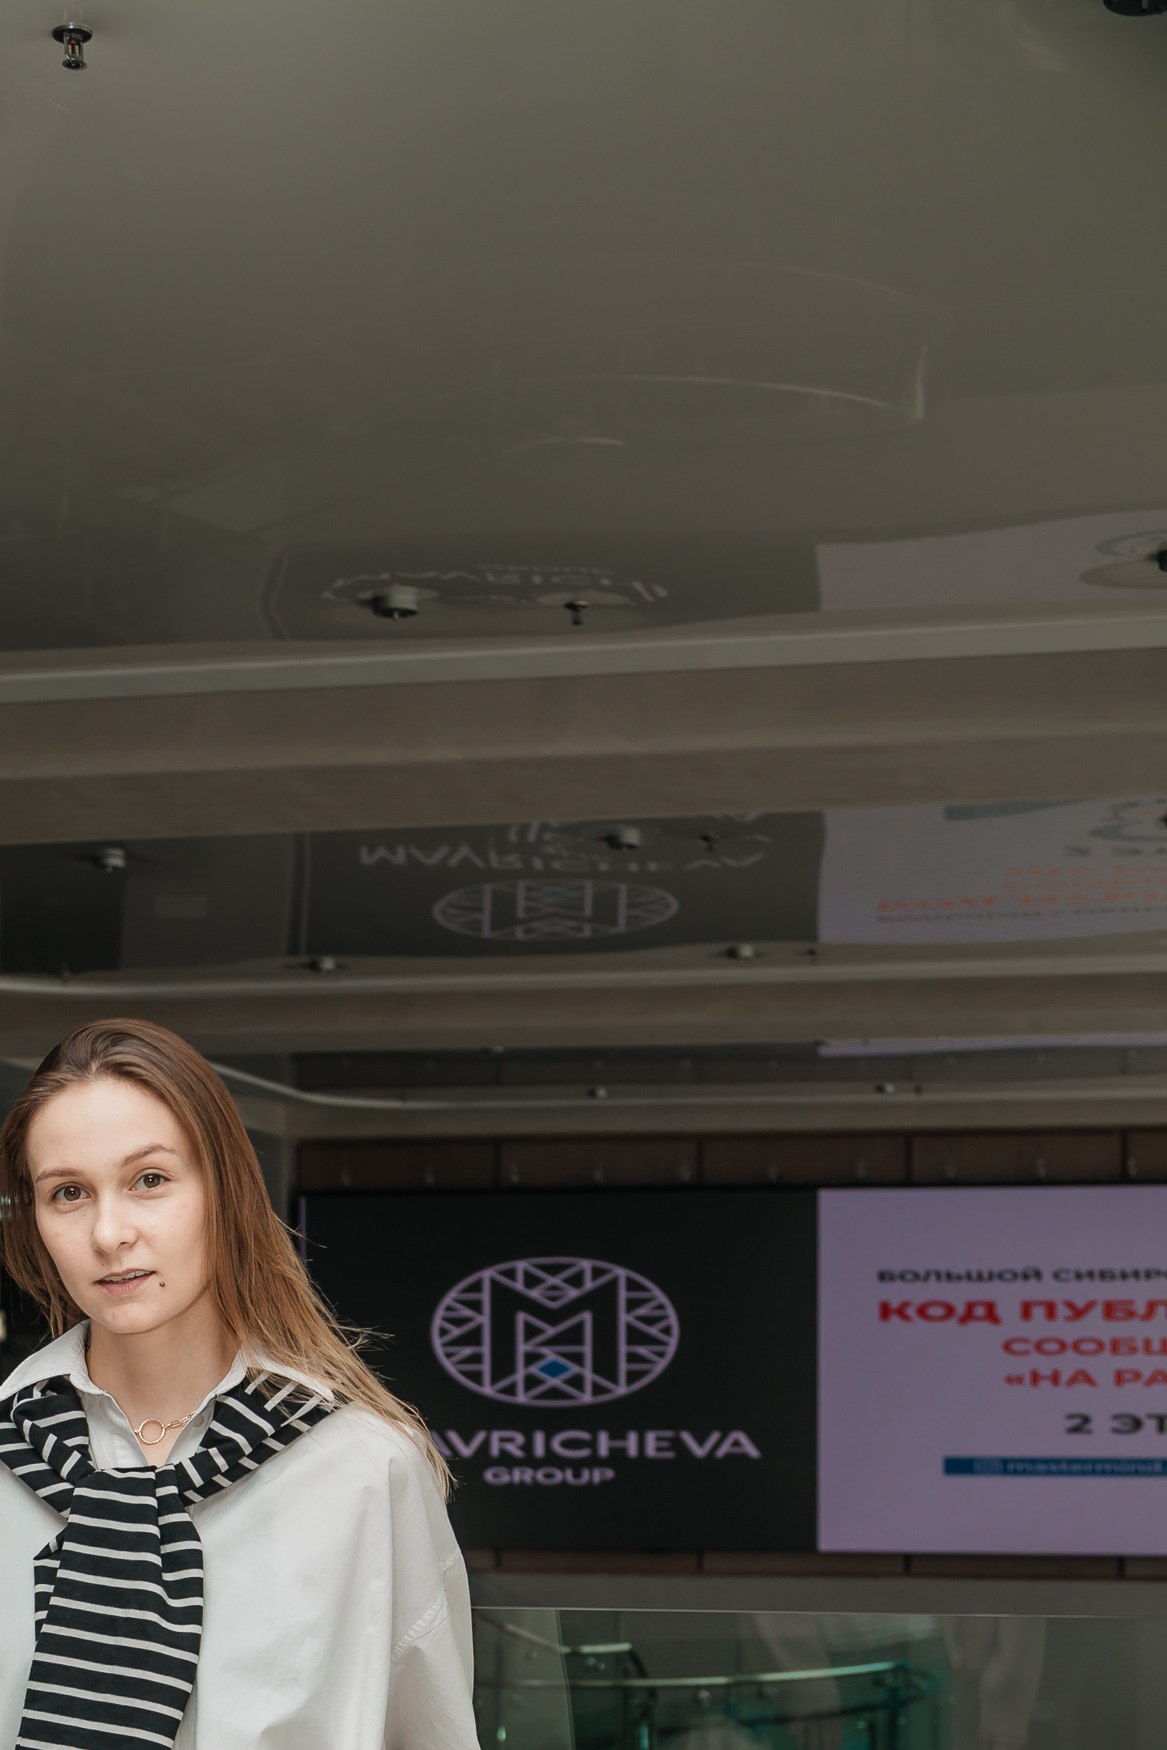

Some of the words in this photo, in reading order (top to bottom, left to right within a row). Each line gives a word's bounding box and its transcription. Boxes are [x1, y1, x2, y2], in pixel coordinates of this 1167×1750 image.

[877, 1266, 1043, 1284] БОЛЬШОЙ
[1052, 1268, 1167, 1284] СИБИР
[879, 1300, 1002, 1327] КОД
[1003, 1368, 1098, 1388] «НА
[1064, 1412, 1094, 1435] 2
[483, 1466, 616, 1486] GROUP
